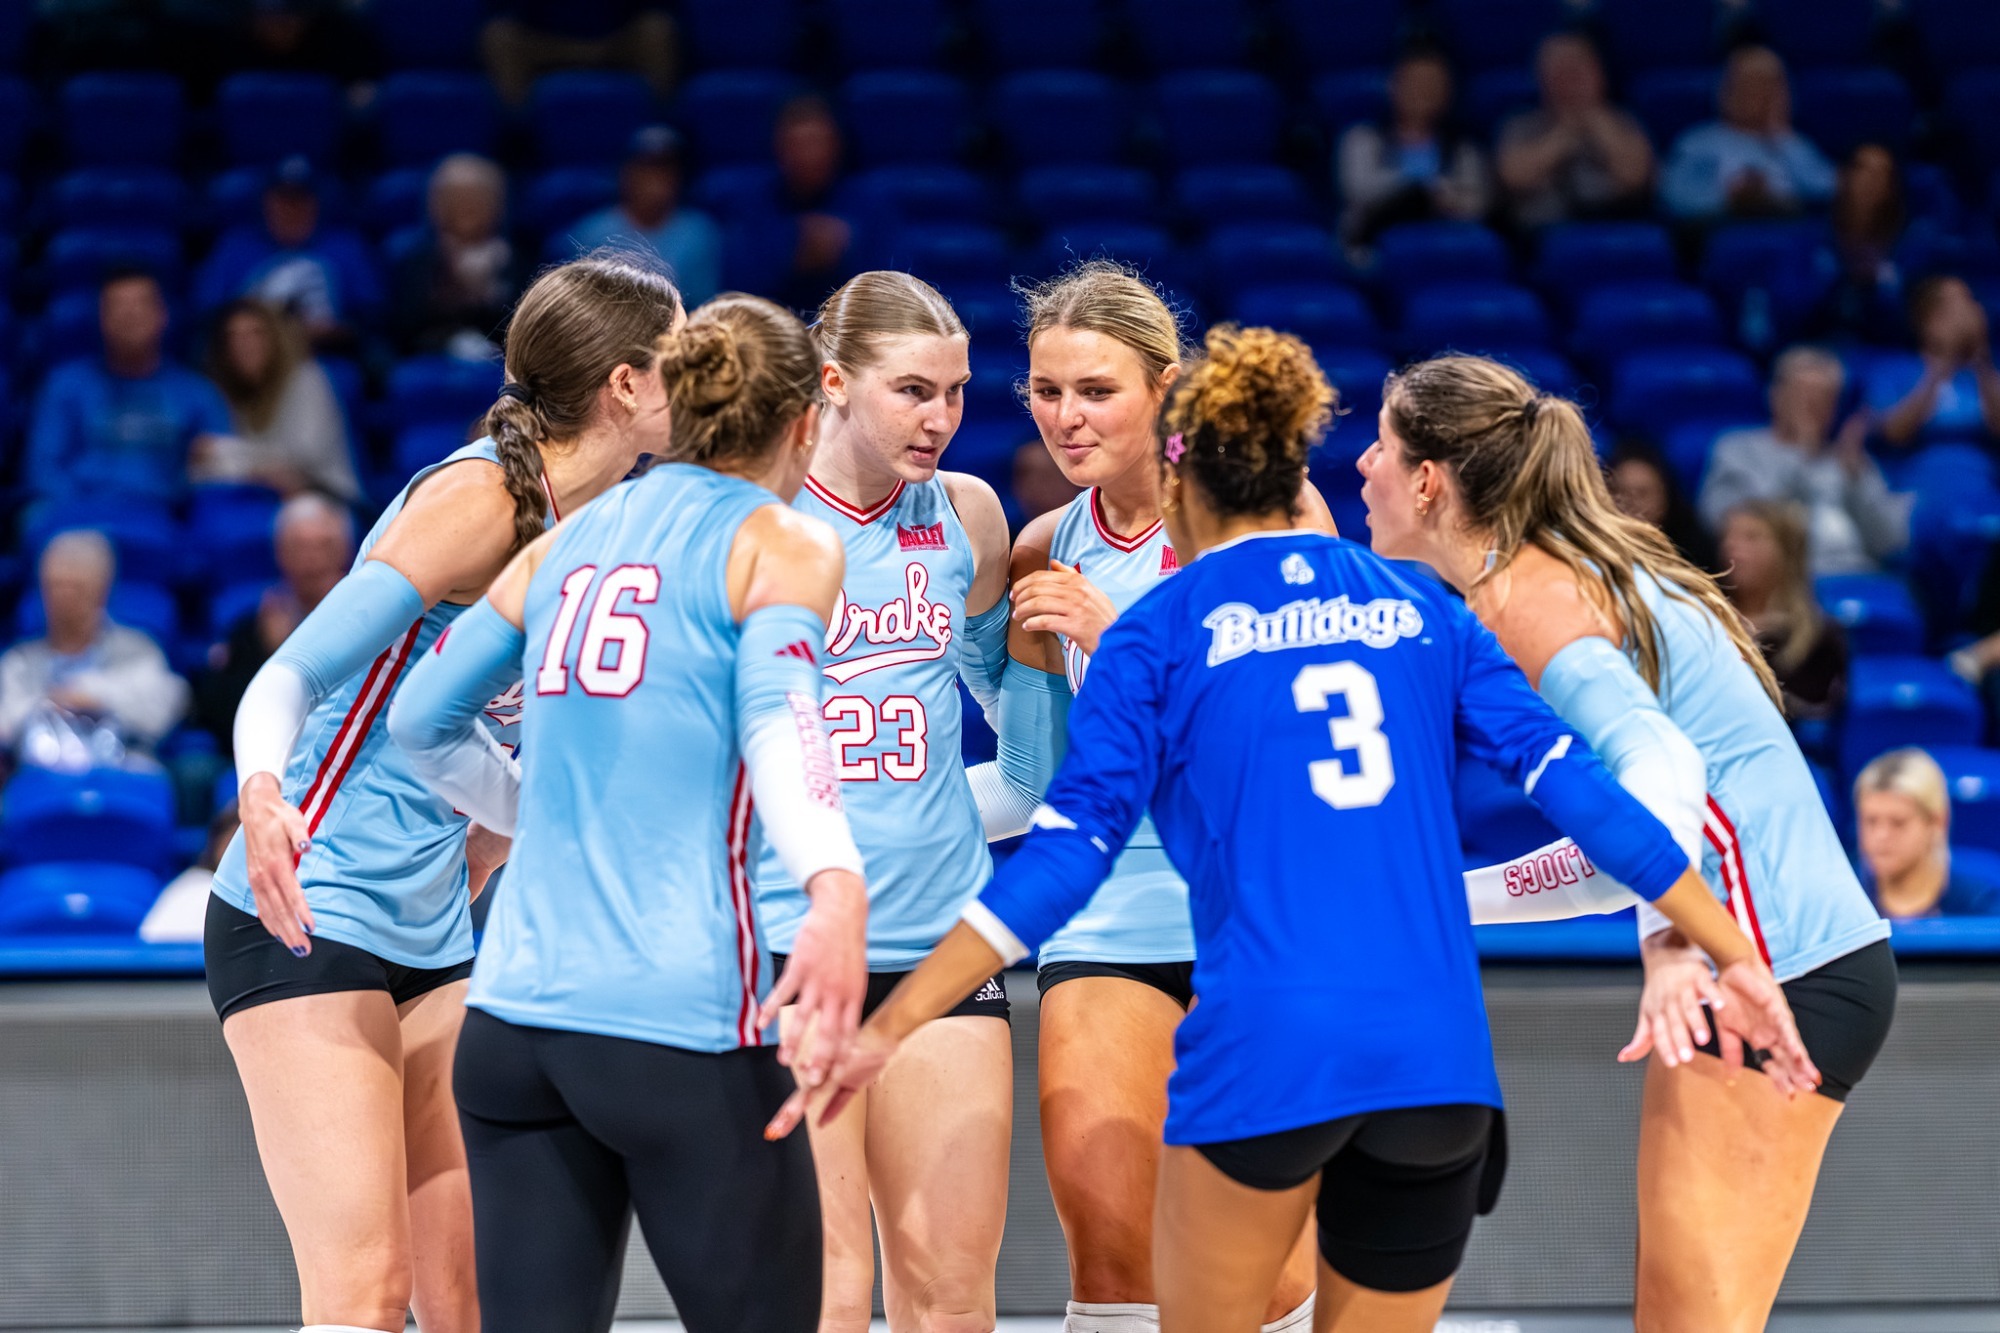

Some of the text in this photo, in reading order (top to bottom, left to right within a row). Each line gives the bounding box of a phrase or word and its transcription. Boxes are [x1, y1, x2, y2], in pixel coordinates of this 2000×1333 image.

[897, 521, 946, 547] VALLEY
[537, 564, 662, 698] 16
[1202, 594, 1424, 667] Bulldogs
[822, 695, 928, 781] 23
[1291, 660, 1395, 810] 3
[975, 989, 1005, 1001] adidas
